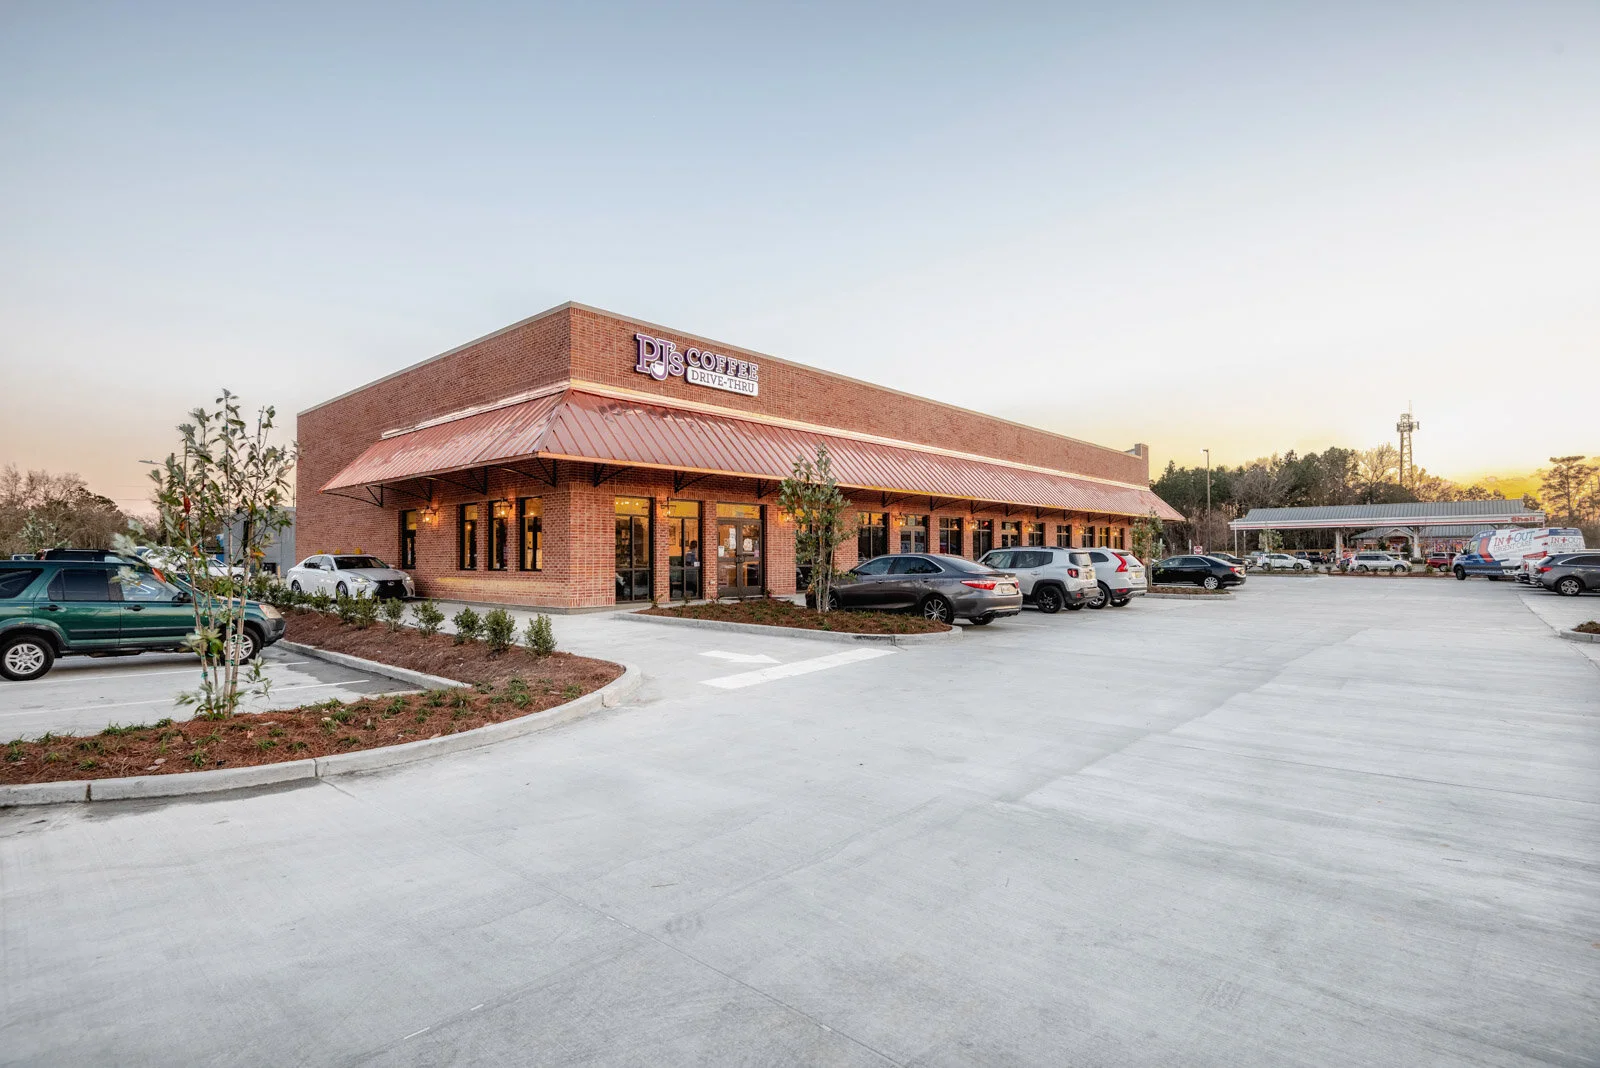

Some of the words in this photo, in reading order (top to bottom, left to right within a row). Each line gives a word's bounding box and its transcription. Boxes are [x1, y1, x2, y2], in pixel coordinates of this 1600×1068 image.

[637, 333, 685, 380] PJ's
[686, 347, 759, 381] COFFEE
[691, 370, 755, 393] DRIVE-THRU
[1514, 530, 1536, 542] OUT
